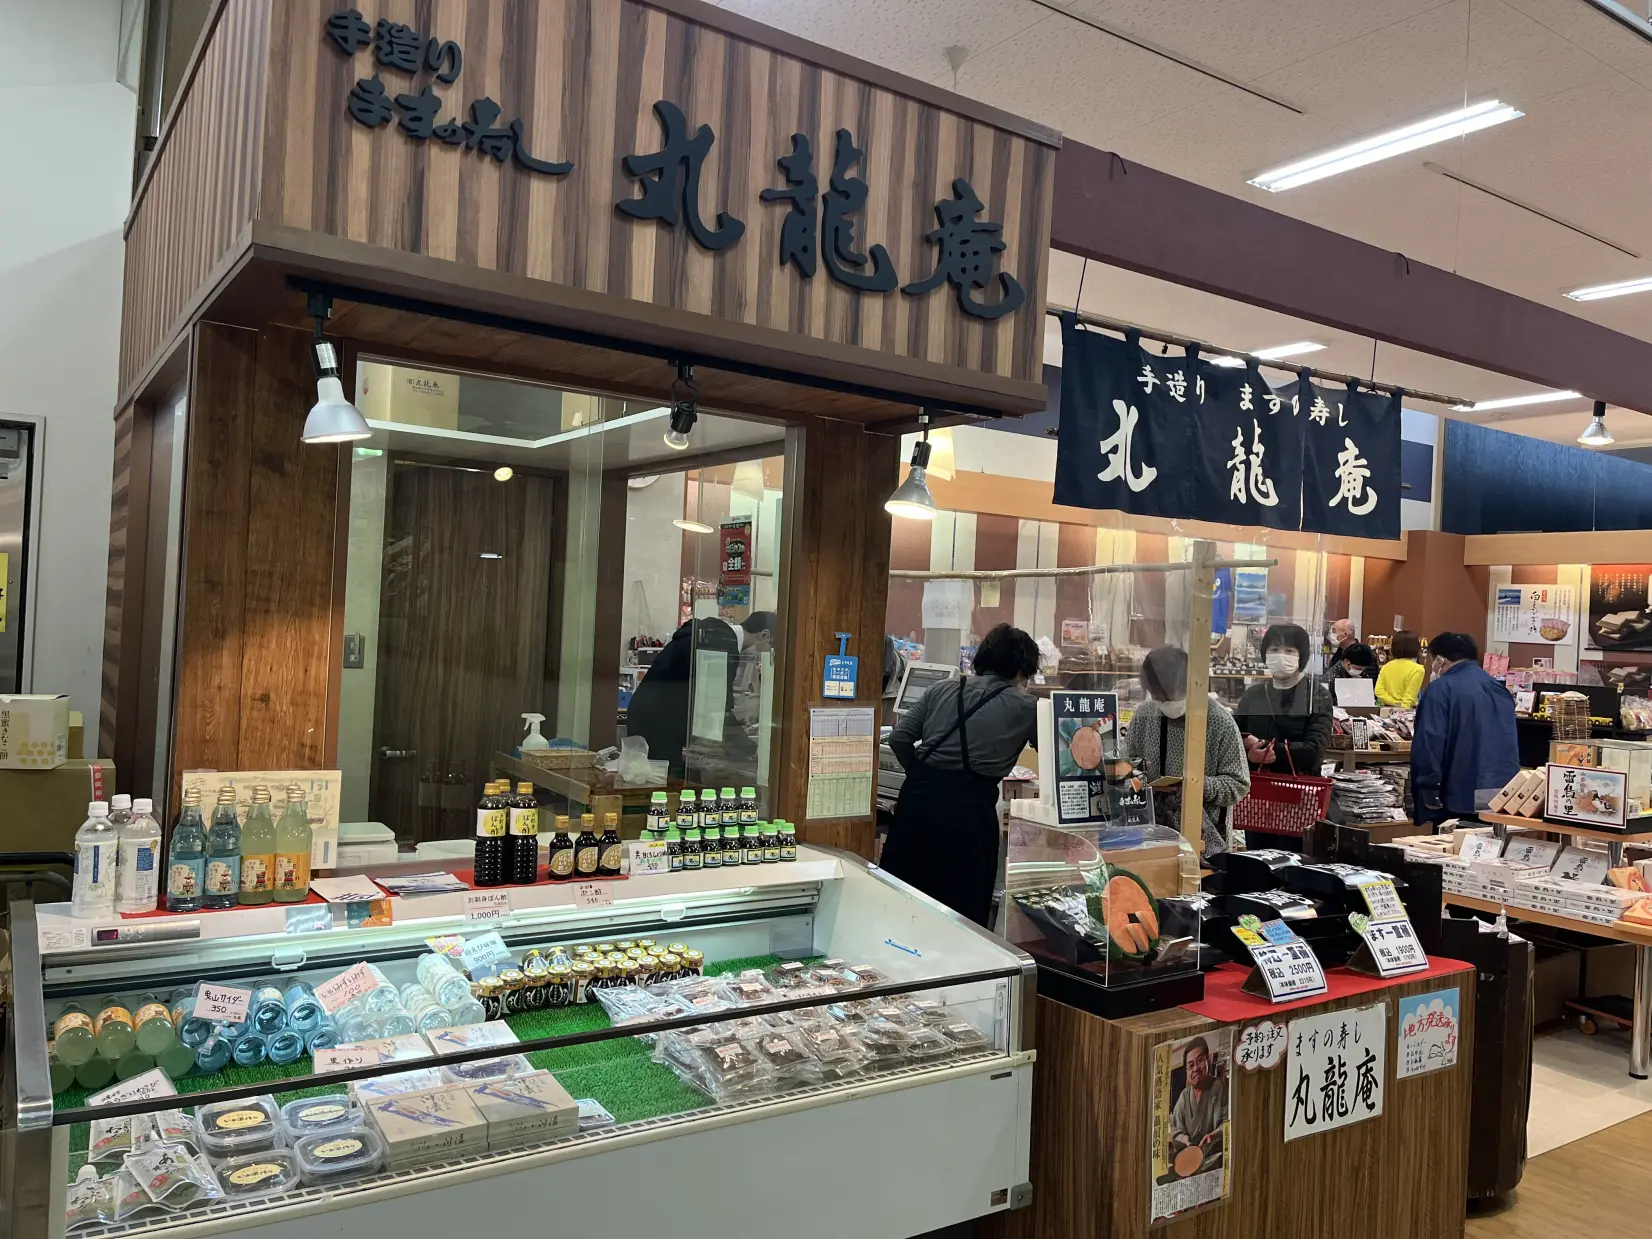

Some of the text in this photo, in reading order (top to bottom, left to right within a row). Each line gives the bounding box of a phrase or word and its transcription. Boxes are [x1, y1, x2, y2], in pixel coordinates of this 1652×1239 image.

[326, 9, 463, 83] 手造り
[347, 73, 576, 175] ますの寿し
[614, 99, 1026, 320] 丸龍庵
[1136, 364, 1205, 405] 手造り
[1097, 399, 1378, 516] 丸龍庵
[1063, 697, 1105, 713] 丸龍庵
[1561, 770, 1579, 816] 雷鳥の里
[470, 909, 501, 920] 1,000円
[473, 950, 495, 963] 900円
[1288, 962, 1315, 975] 2500円
[204, 990, 243, 1004] 曳山サイダー
[211, 1004, 227, 1013] 350
[1245, 1026, 1285, 1047] 予約・注文
[1295, 1022, 1362, 1057] ますの寿し
[1241, 1043, 1275, 1063] 承ります
[1289, 1047, 1379, 1129] 丸龍庵
